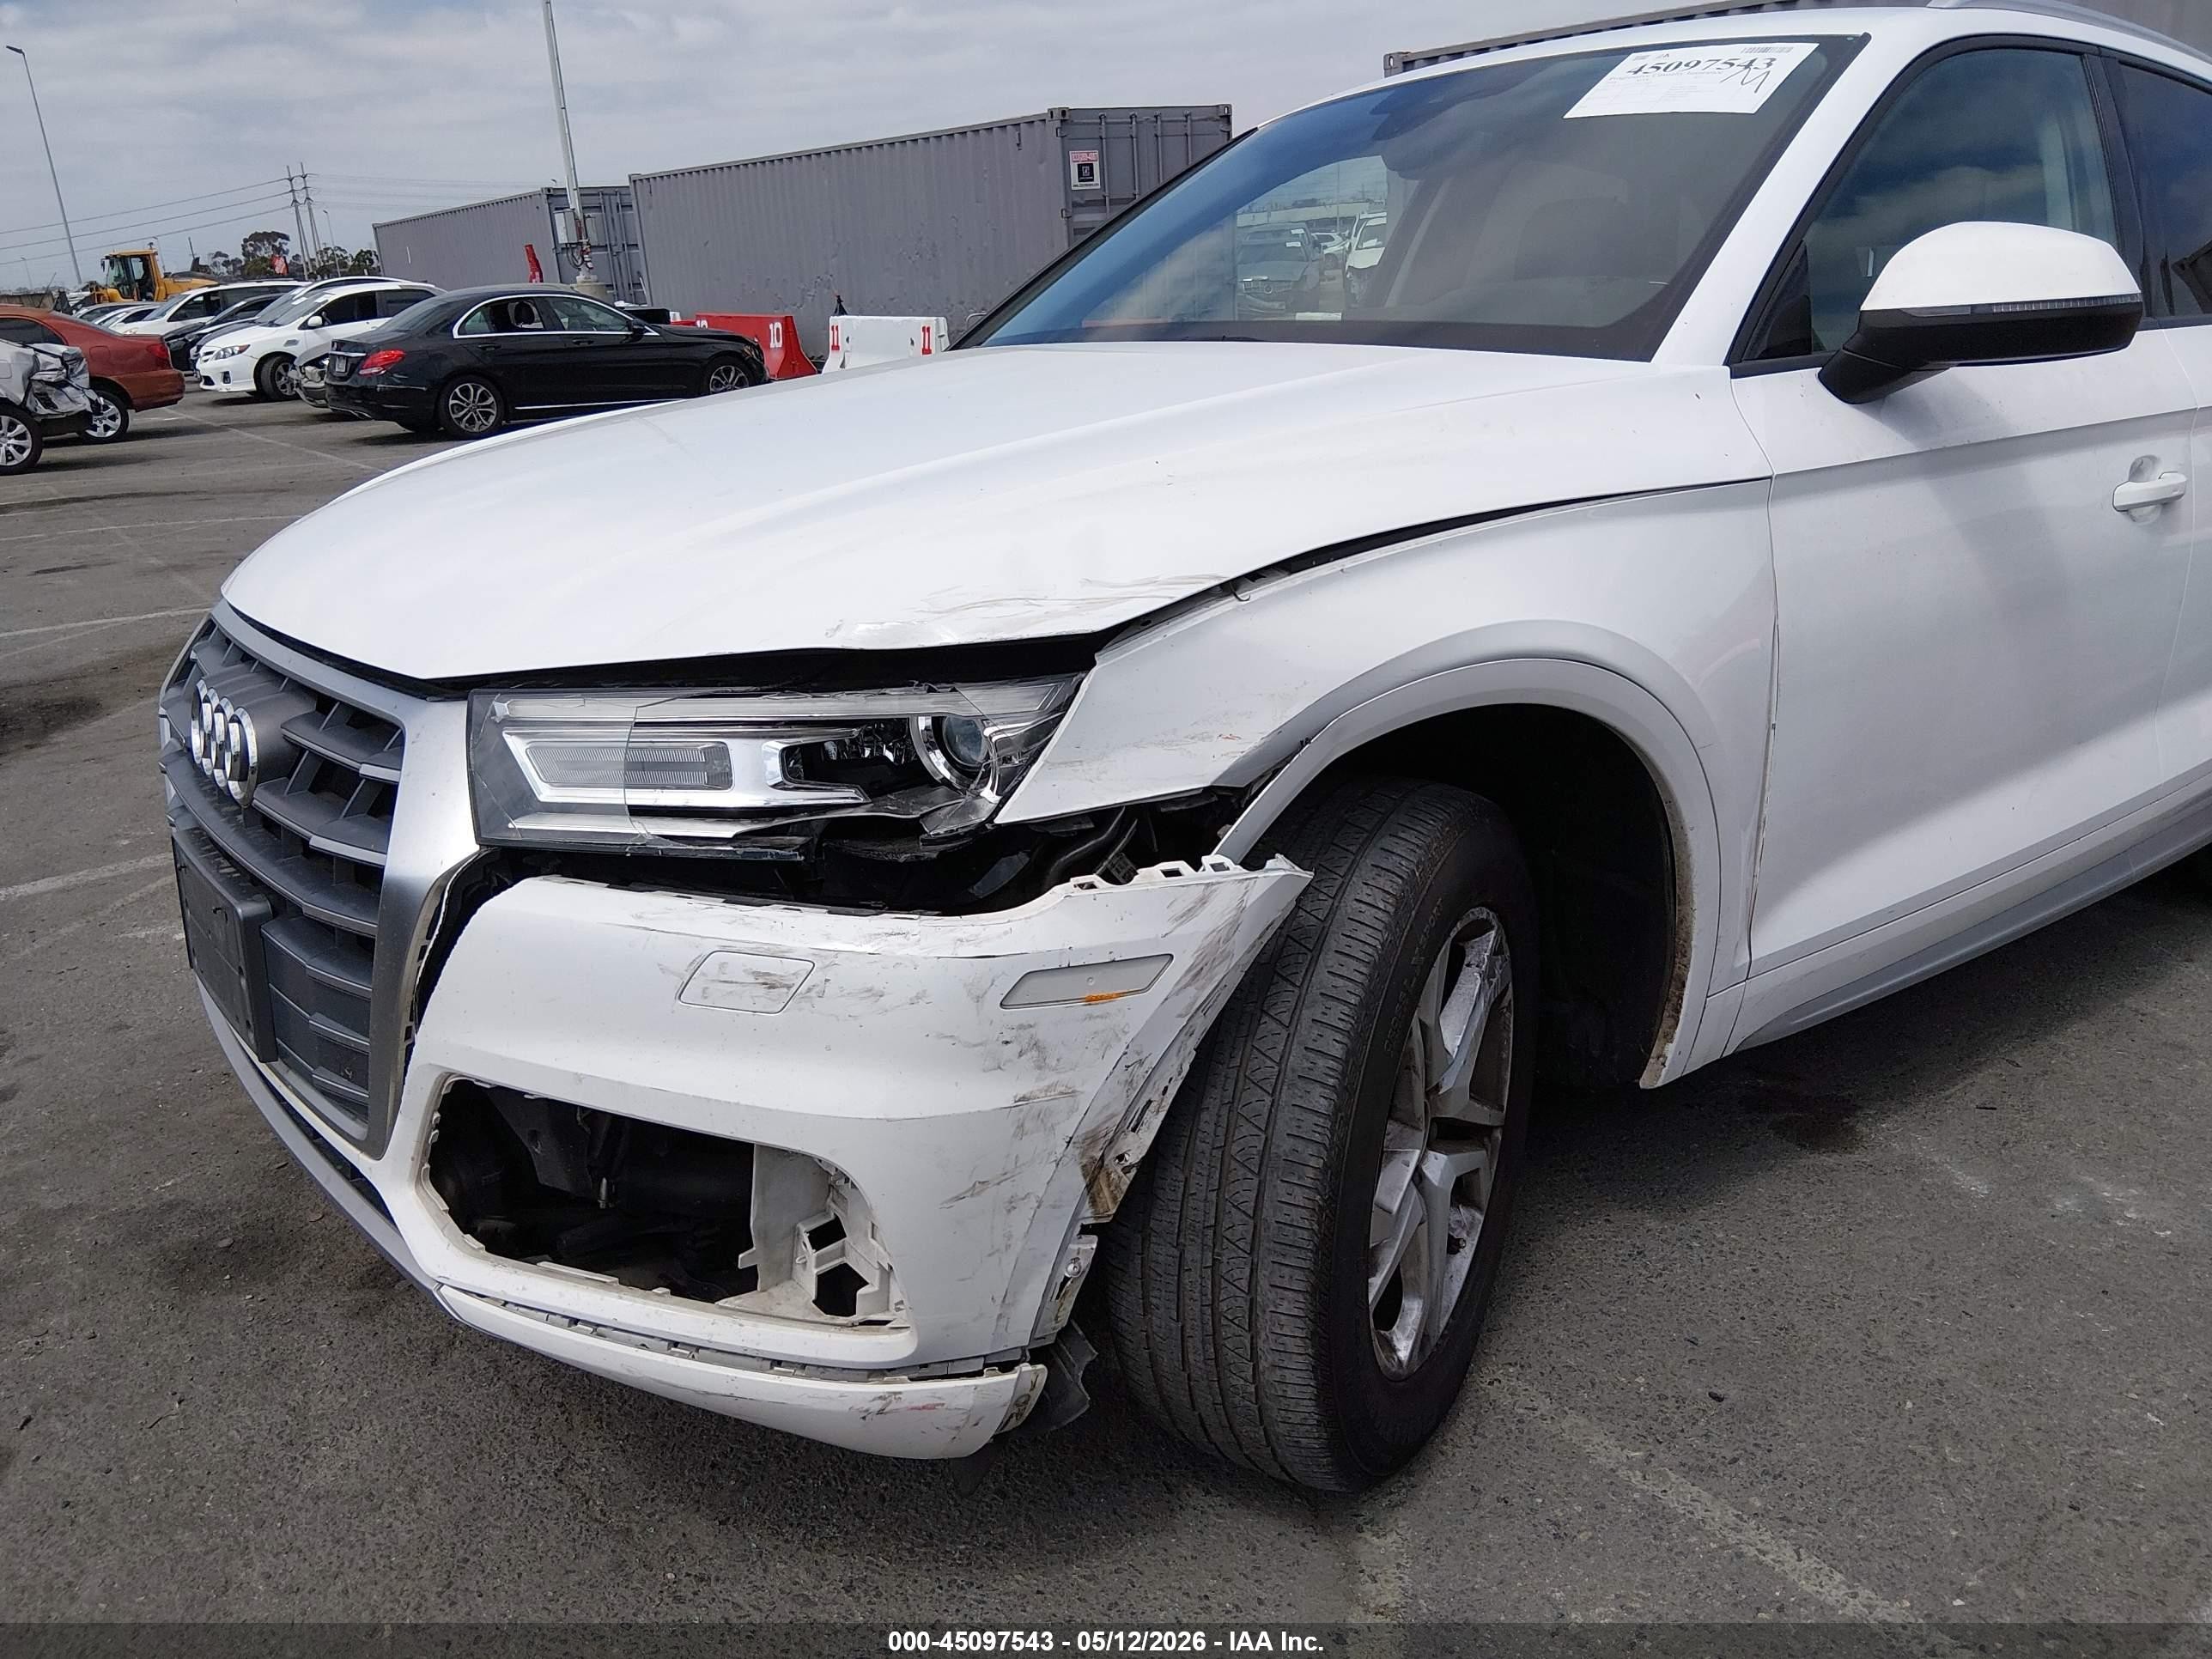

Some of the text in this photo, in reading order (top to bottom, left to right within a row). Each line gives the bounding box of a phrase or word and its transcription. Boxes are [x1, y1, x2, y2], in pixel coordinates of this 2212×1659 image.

[1627, 58, 1777, 76] 45097543
[769, 322, 783, 349] 10
[831, 325, 841, 351] 11
[921, 325, 933, 356] 11
